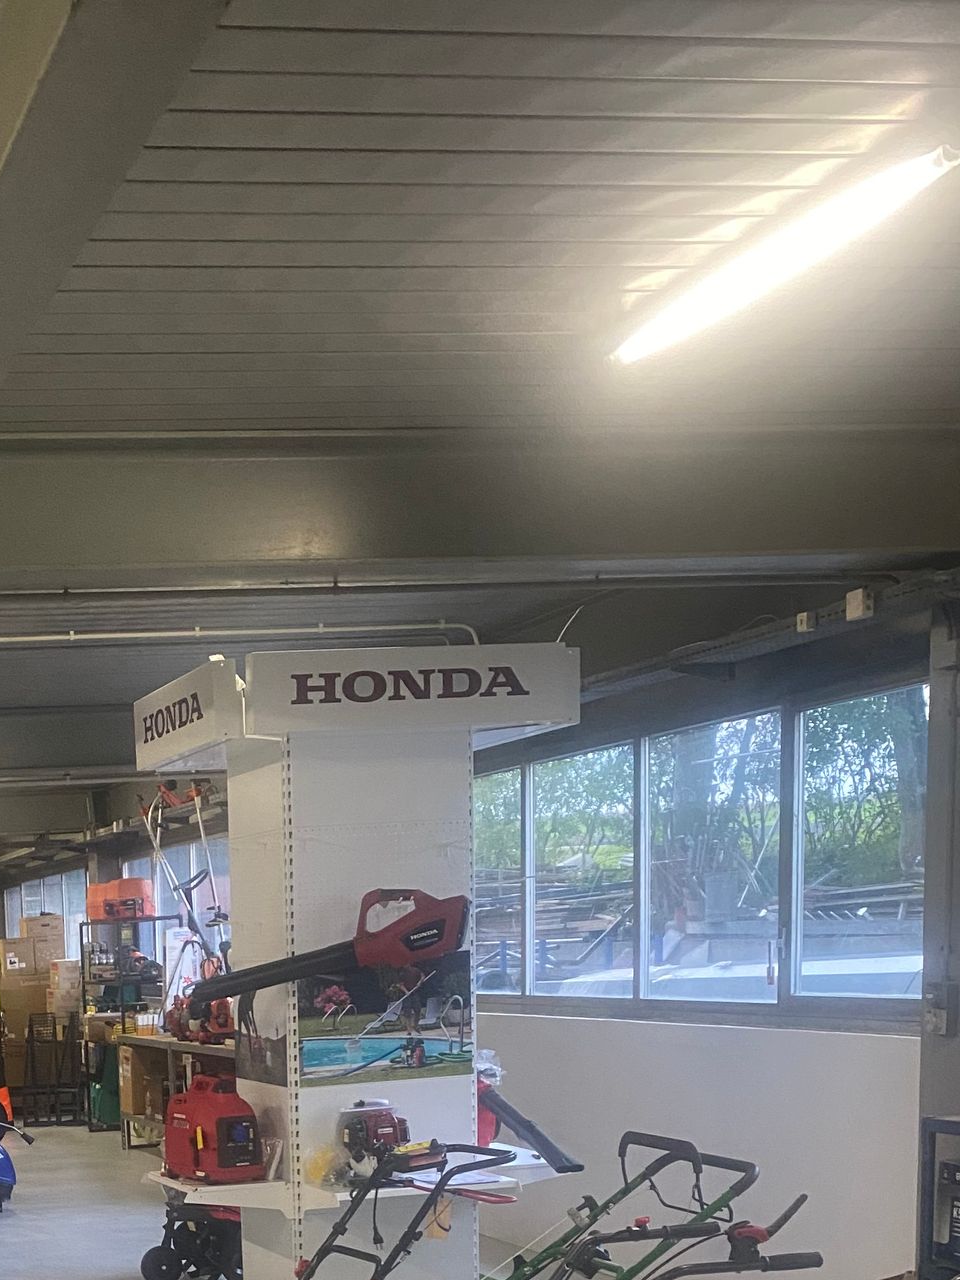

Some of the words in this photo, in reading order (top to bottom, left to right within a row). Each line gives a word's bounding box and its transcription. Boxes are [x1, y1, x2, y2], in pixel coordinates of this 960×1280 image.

[290, 665, 531, 705] HONDA
[143, 692, 205, 744] HONDA
[410, 929, 439, 940] HONDA
